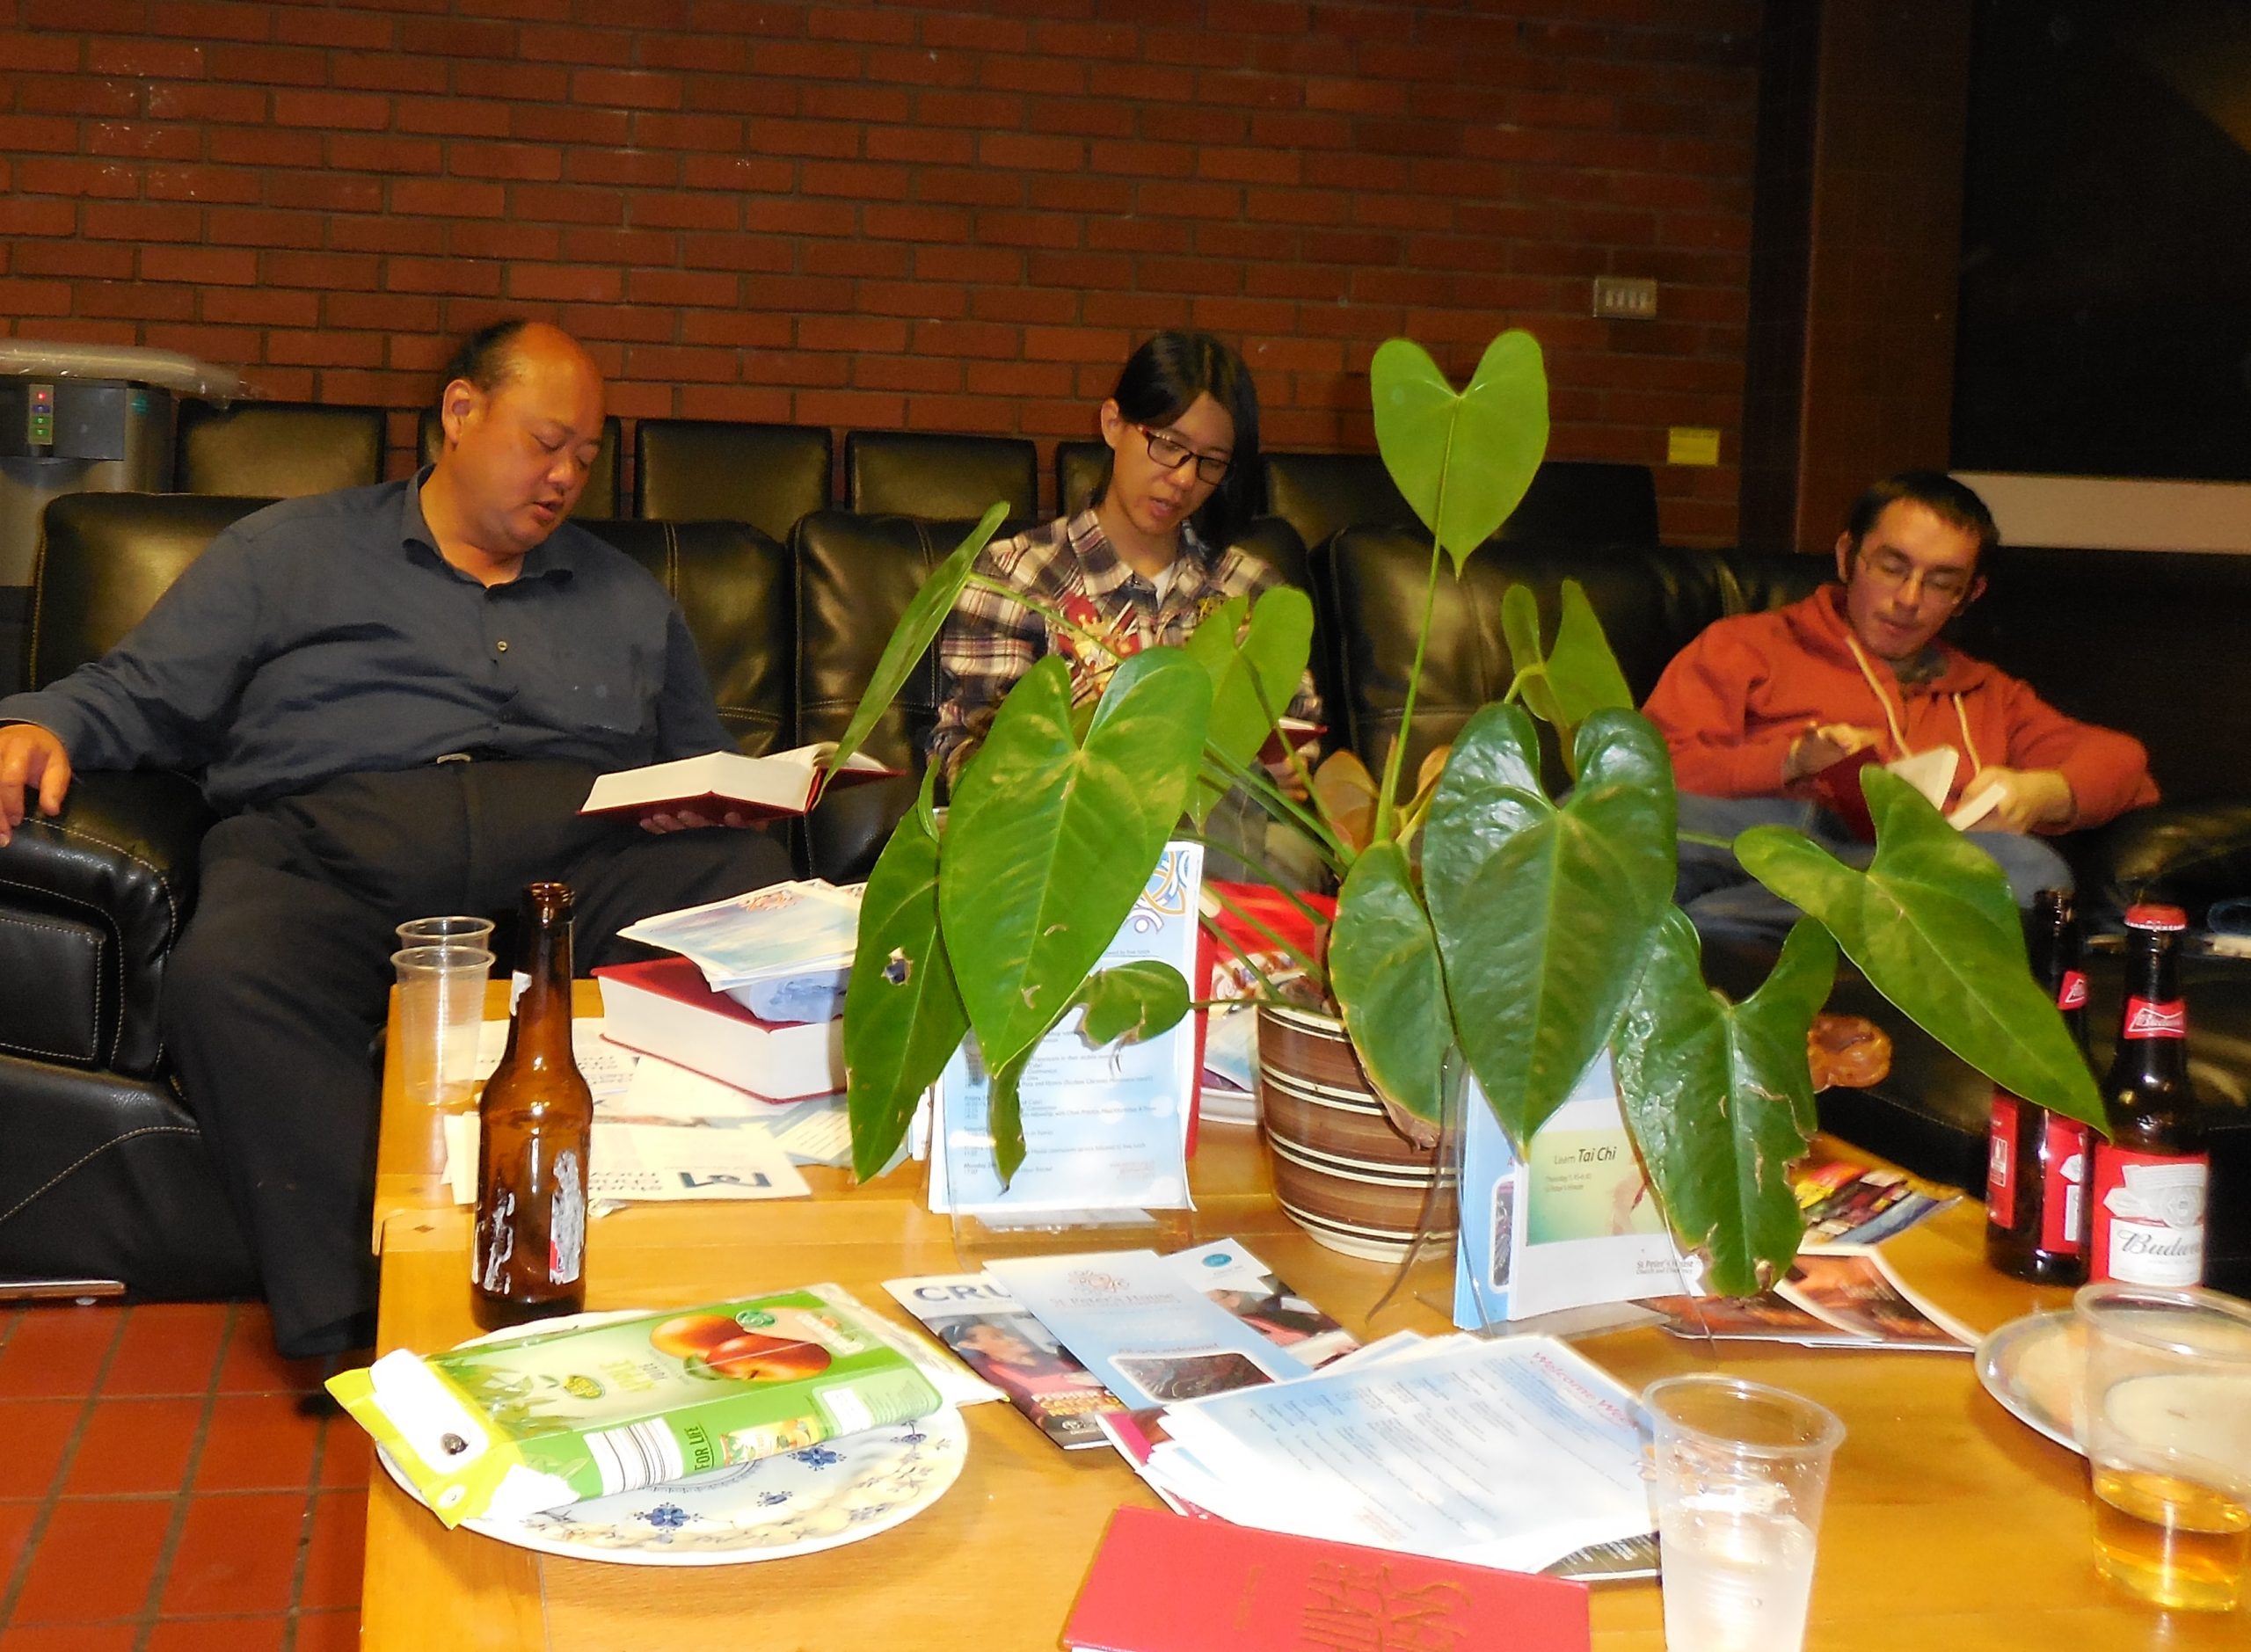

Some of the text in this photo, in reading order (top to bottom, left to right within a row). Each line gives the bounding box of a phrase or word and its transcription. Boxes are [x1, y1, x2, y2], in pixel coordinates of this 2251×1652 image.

[1577, 1147, 1596, 1163] Tai
[1597, 1146, 1618, 1161] Chi
[1532, 1351, 1598, 1401] Welcome
[695, 1447, 710, 1471] FOR
